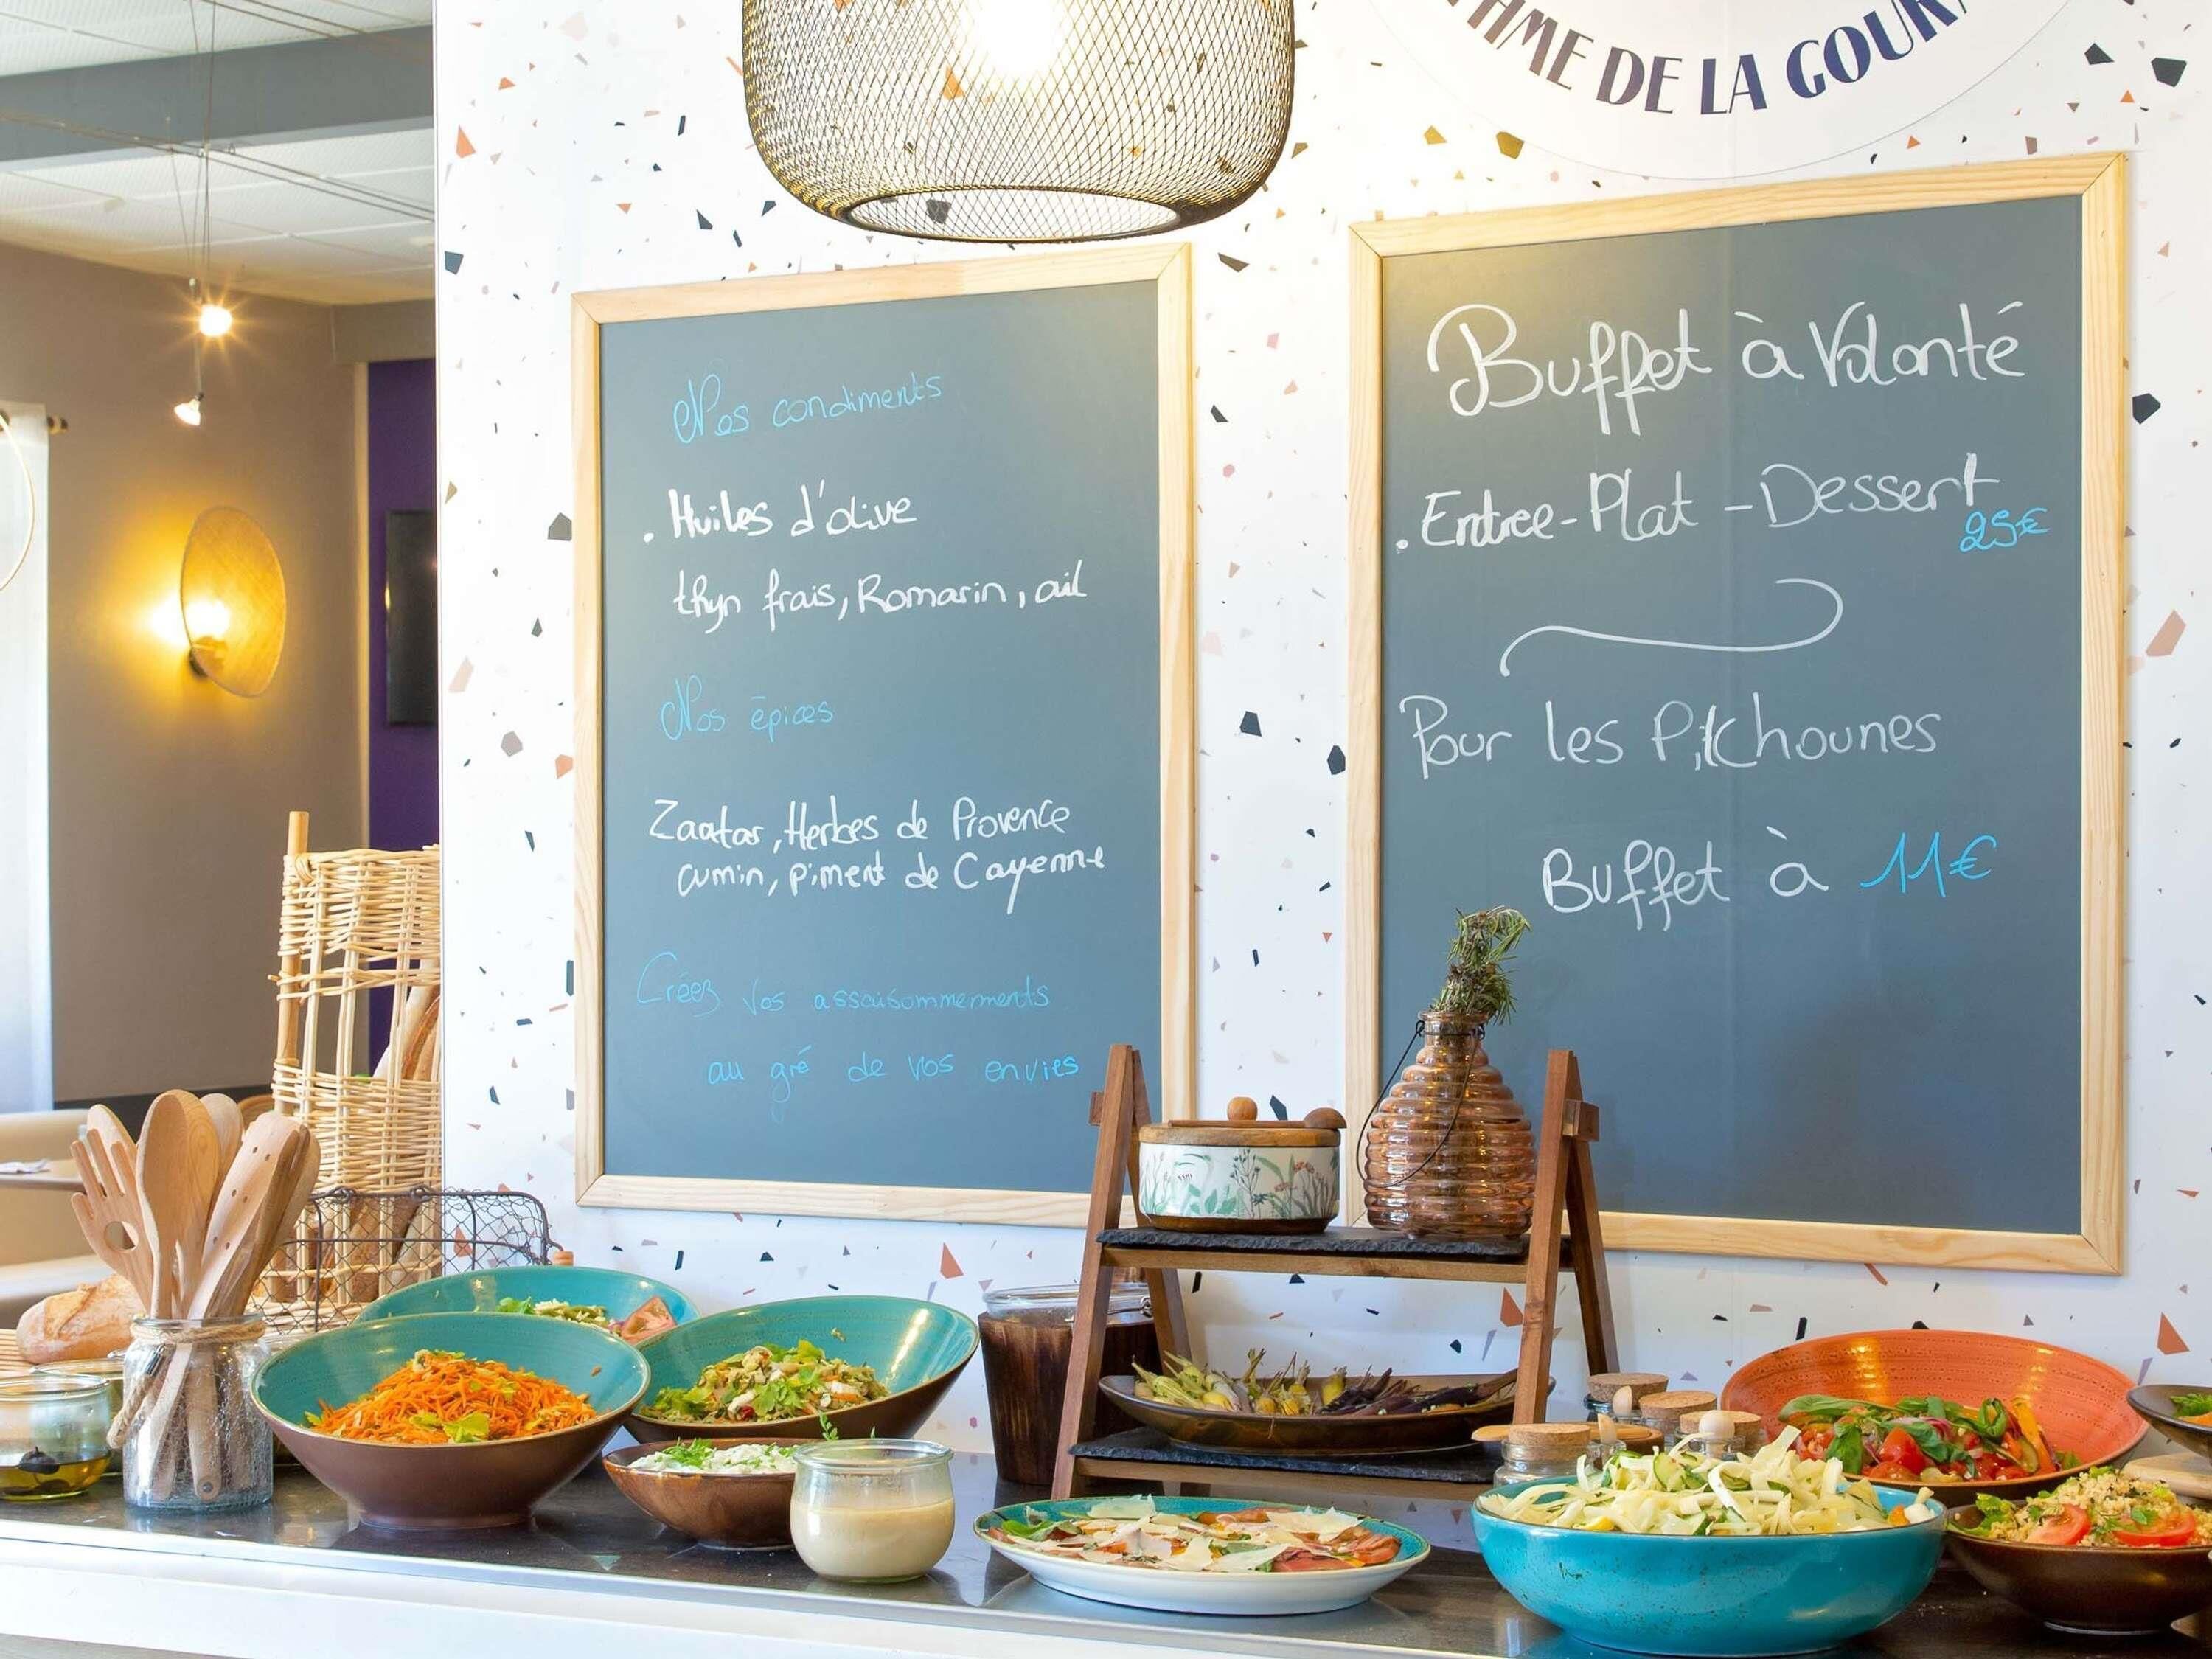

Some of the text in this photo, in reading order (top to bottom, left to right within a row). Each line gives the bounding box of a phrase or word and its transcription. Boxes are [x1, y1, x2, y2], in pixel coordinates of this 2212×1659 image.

[1596, 46, 1683, 114] DE
[1700, 54, 1767, 115] LA
[1734, 311, 1804, 380] à
[773, 372, 942, 428] condiments
[669, 479, 917, 538] Huiles d'olive
[1959, 507, 2051, 552] 25€
[1035, 560, 1087, 603] ail
[660, 675, 725, 740] Nos
[1399, 695, 1512, 780] Pour
[1545, 700, 1623, 764] les
[784, 795, 879, 851] Herbes
[897, 799, 928, 839] de
[953, 796, 1070, 841] Provence
[790, 849, 886, 897] piment
[905, 852, 939, 889] de
[953, 846, 1105, 915] Cayenne
[1543, 826, 1997, 931] Buffet à 11€
[708, 1062, 744, 1085] au
[771, 1045, 811, 1102] gré
[848, 1051, 887, 1082] de
[985, 1054, 1079, 1084] envies
